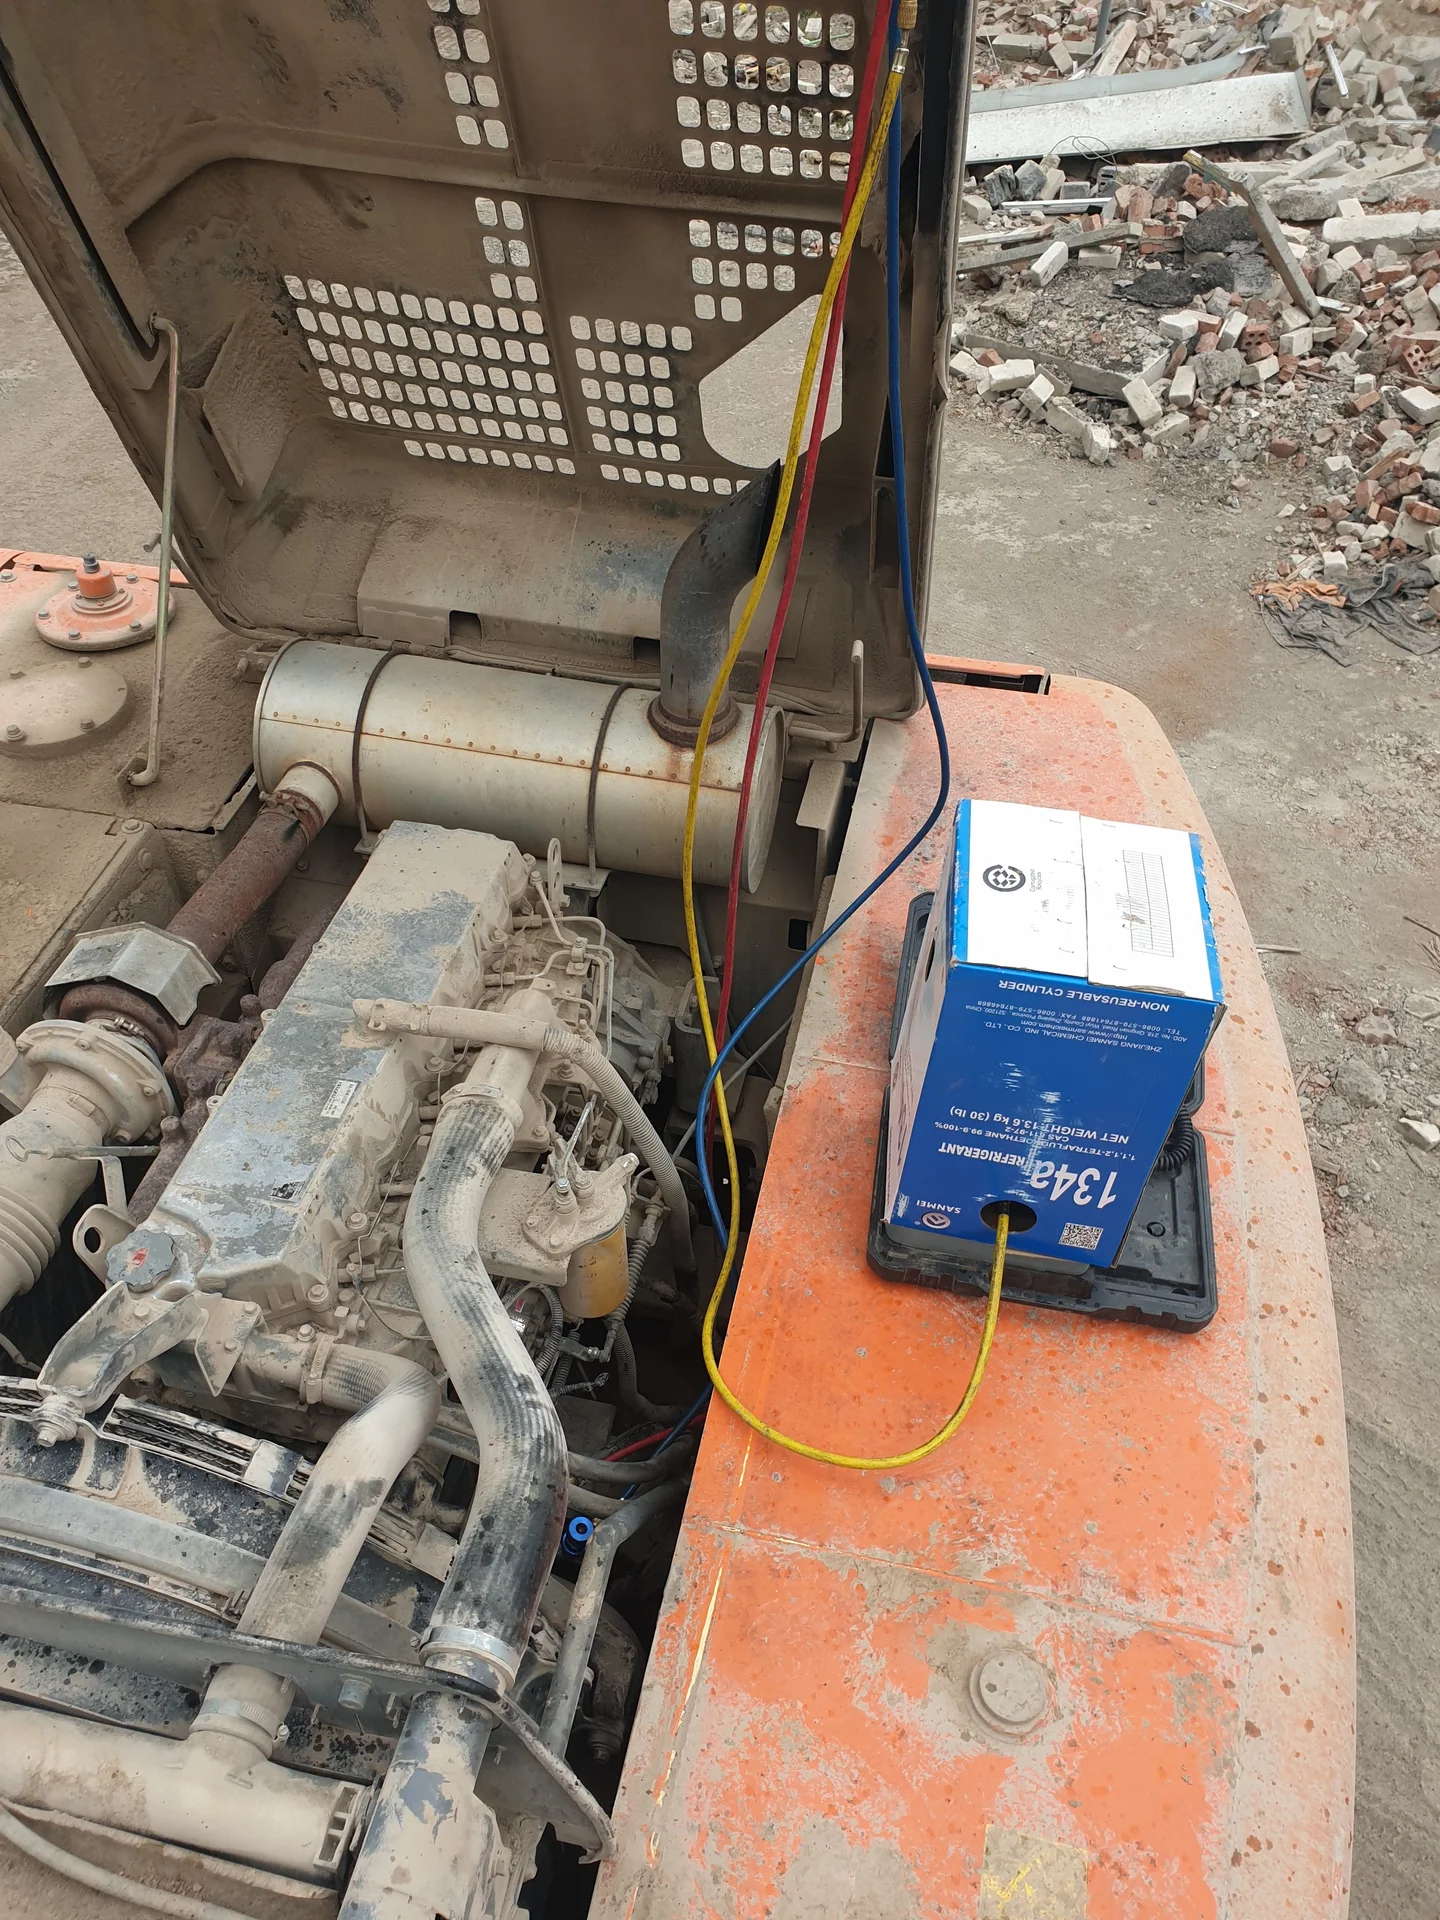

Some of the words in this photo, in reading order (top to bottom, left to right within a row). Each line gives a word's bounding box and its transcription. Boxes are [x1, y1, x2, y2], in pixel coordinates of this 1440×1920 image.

[998, 980, 1064, 997] CYLINDER
[1066, 990, 1170, 1012] NON-REUSABLE
[965, 1004, 983, 1012] China
[1036, 1015, 1063, 1024] Zhejiang
[1058, 1012, 1077, 1020] FAX:
[984, 1021, 1002, 1029] LTD.
[1004, 1024, 1021, 1032] CO.,
[1020, 1020, 1128, 1041] http://www.sanmeichem.com
[1023, 1027, 1040, 1035] IND.
[1042, 1030, 1085, 1041] CHEMICAL
[1164, 1028, 1181, 1036] TEL:
[1086, 1036, 1119, 1046] SANMEI
[1120, 1042, 1163, 1053] ZHEJIANG
[950, 1106, 966, 1118] lb)
[970, 1111, 990, 1122] (30
[993, 1113, 1010, 1125] kg
[1013, 1118, 1038, 1130] 13.6
[935, 1122, 983, 1136] 99.9-100%
[1048, 1134, 1069, 1143] CAS
[1100, 1132, 1129, 1145] NET
[985, 1130, 1136, 1161] 1,1,1,2-TETRAFLUOOETHANE
[938, 1142, 1026, 1166] REFRIGERANT
[1031, 1160, 1118, 1209] 134a
[916, 1200, 961, 1214] SANMEI
